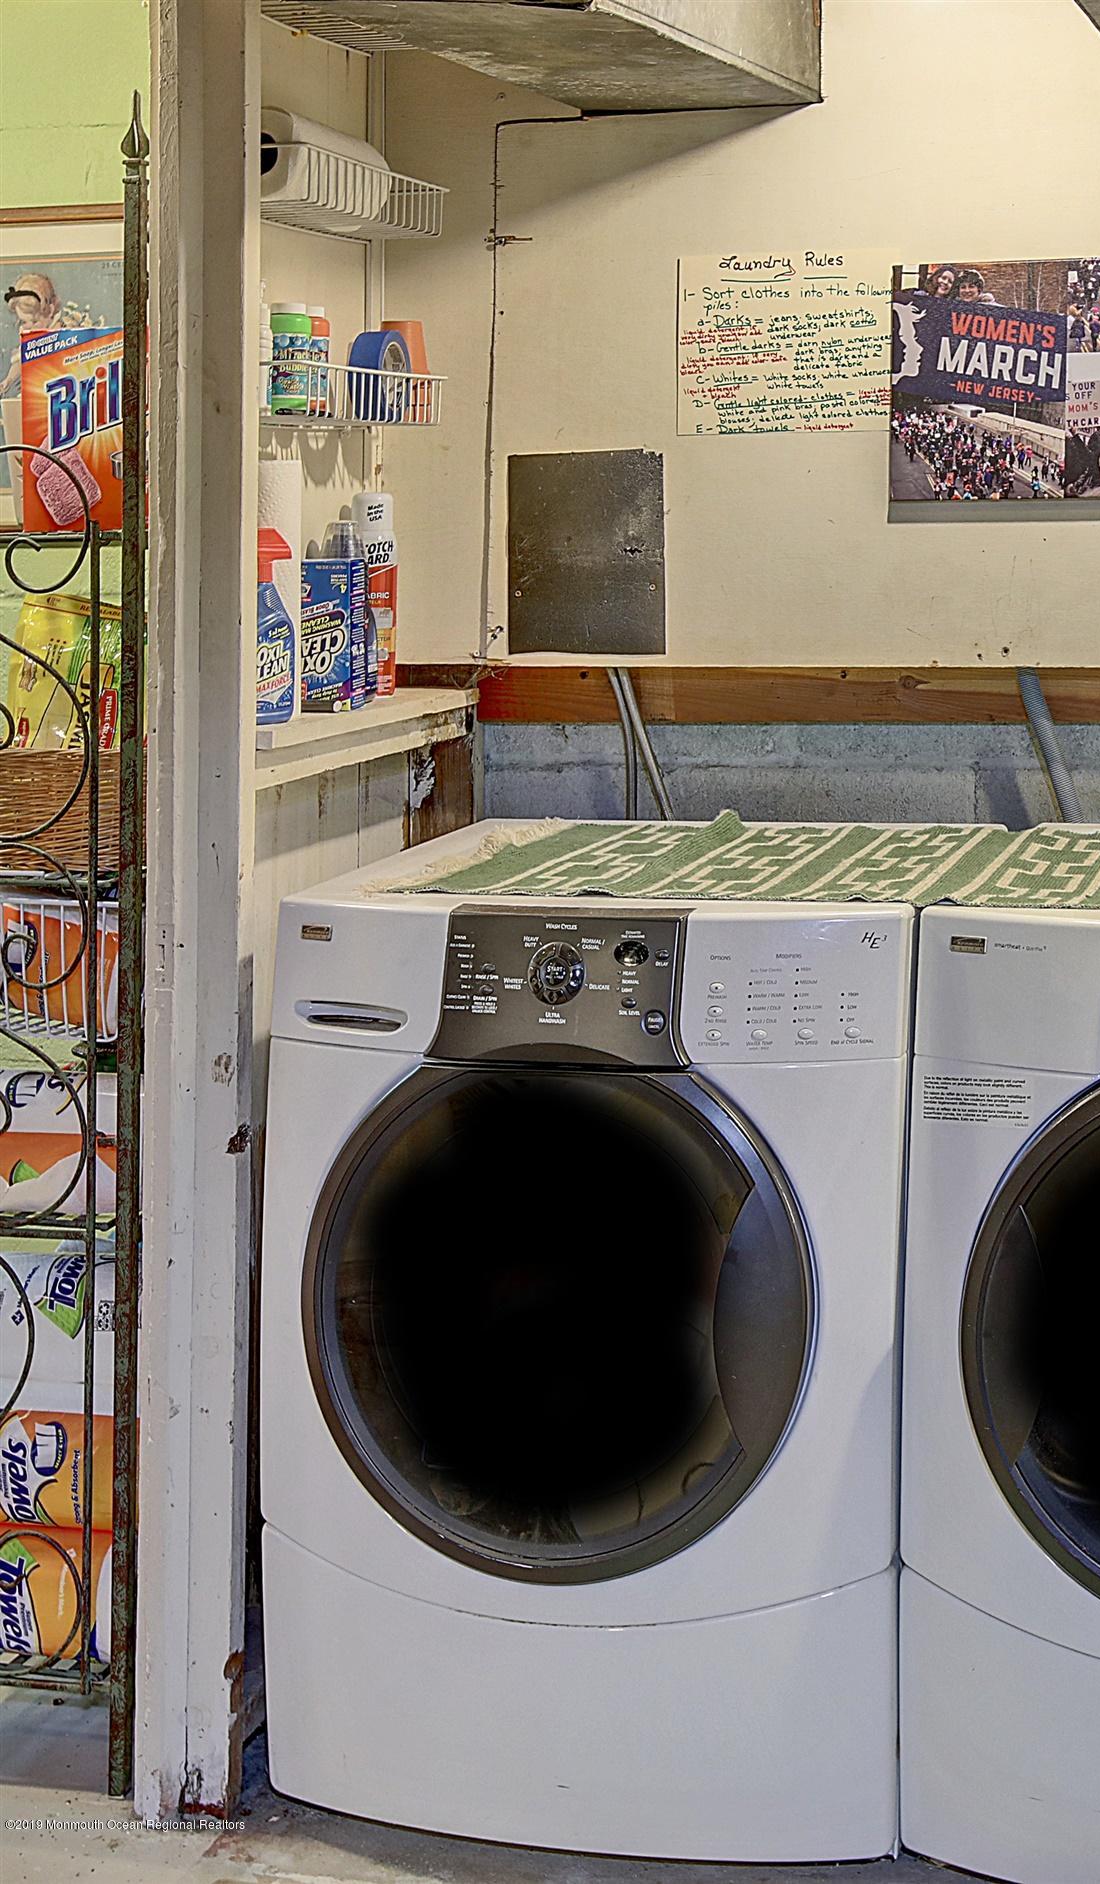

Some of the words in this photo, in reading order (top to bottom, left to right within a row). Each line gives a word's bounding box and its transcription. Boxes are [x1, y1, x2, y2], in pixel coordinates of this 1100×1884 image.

[718, 255, 796, 279] Laundry
[805, 251, 844, 267] Rules
[702, 286, 735, 301] Sort
[740, 286, 790, 299] clothes
[800, 284, 823, 298] into
[826, 283, 850, 297] the
[824, 319, 846, 328] dark
[951, 311, 1056, 349] WOMEN'S
[25, 345, 54, 360] VALUE
[54, 335, 78, 350] PACK
[936, 336, 1063, 390] MARCH
[1072, 382, 1096, 391] YOUR
[1075, 391, 1093, 400] OFF
[1068, 402, 1099, 412] MOM'S
[366, 541, 394, 555] OTCH
[257, 643, 281, 668] OXI
[271, 673, 291, 690] FORCE
[104, 695, 113, 721] PRIME
[71, 1450, 81, 1494] Absorbent
